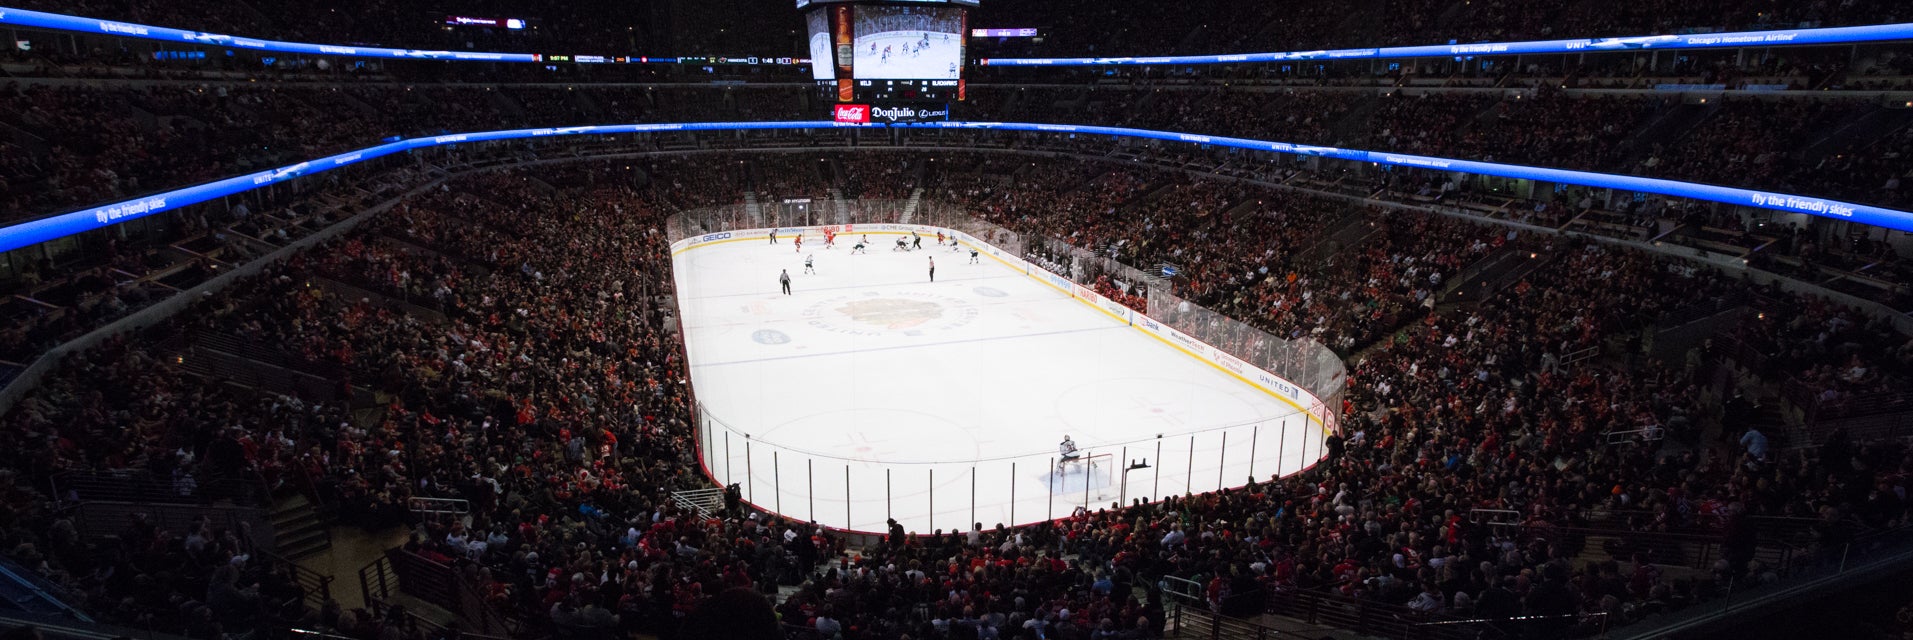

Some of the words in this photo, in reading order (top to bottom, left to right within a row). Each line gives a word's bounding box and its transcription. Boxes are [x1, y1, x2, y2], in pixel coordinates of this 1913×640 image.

[1688, 37, 1721, 45] Chicago's
[1722, 35, 1764, 43] Hometown
[1469, 45, 1491, 53] friendly
[96, 210, 108, 223] fly
[108, 207, 122, 220] the
[121, 201, 148, 217] friendly
[149, 197, 166, 210] skies
[1752, 193, 1766, 205] fly
[1768, 195, 1784, 207] the
[1786, 197, 1828, 214] friendly
[1829, 204, 1853, 217] skies
[703, 232, 731, 242] GEICO
[1146, 319, 1160, 331] bank
[1170, 330, 1205, 352] WeatherTech
[1259, 374, 1290, 393] UNITED
